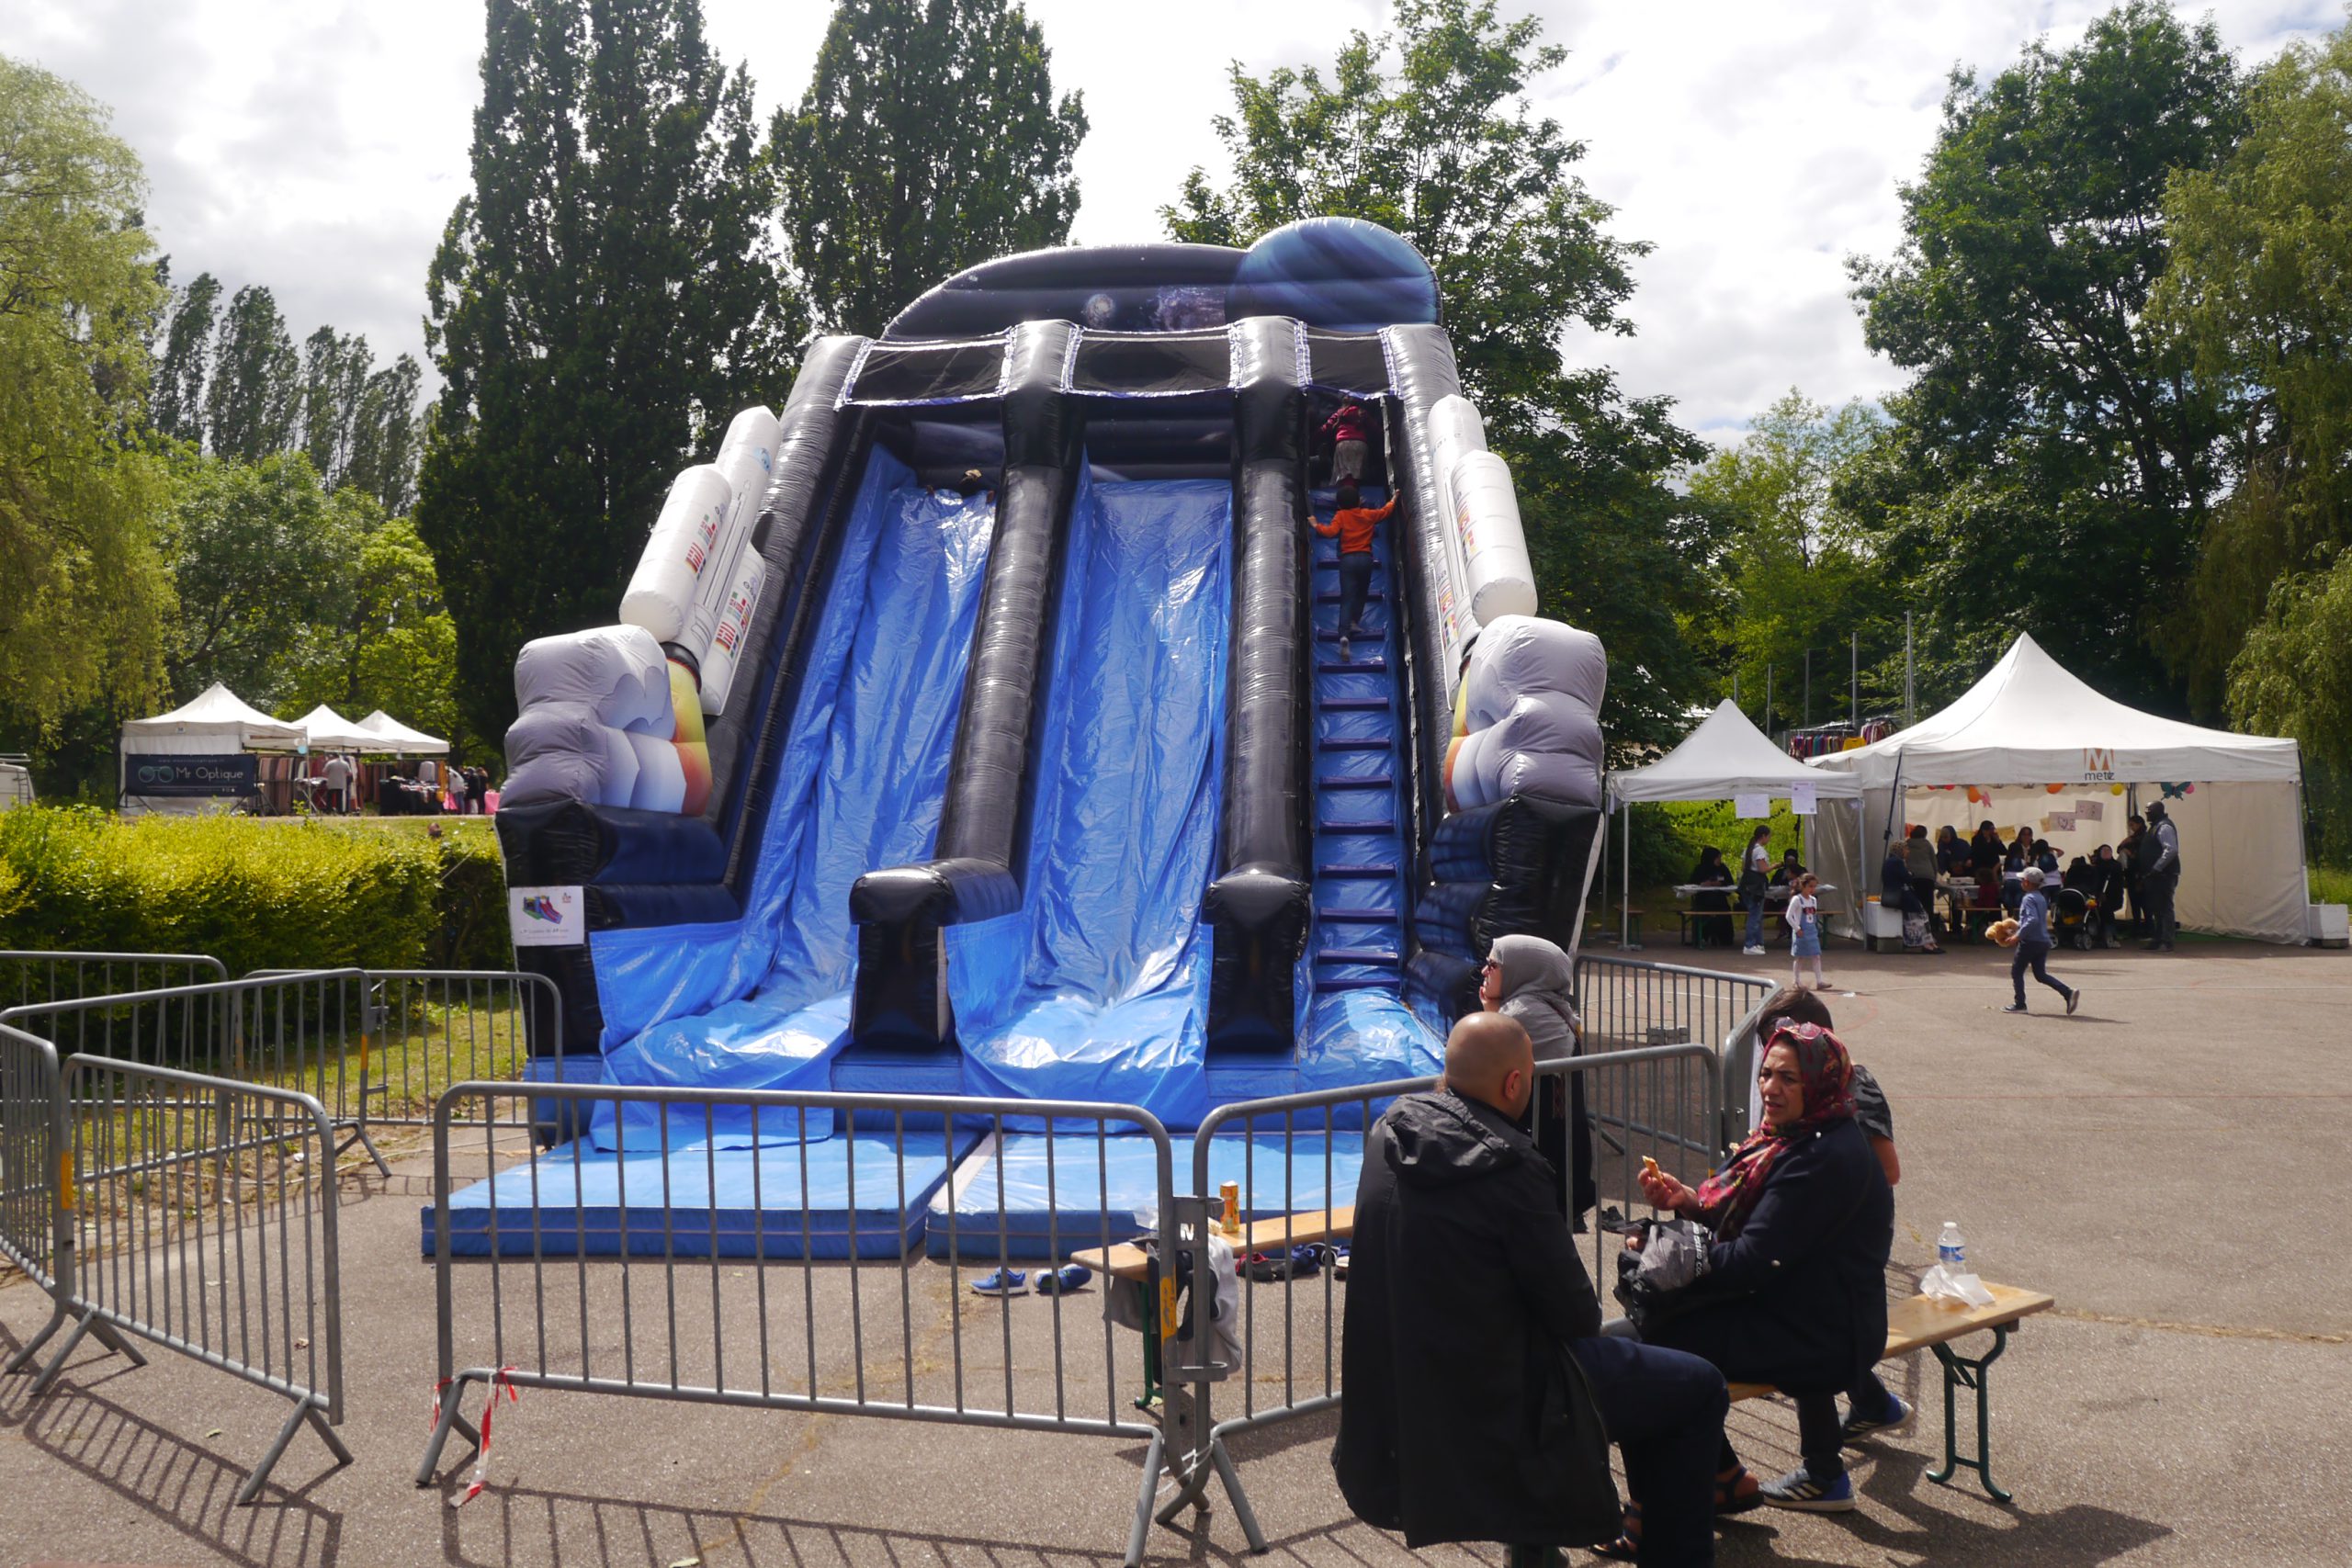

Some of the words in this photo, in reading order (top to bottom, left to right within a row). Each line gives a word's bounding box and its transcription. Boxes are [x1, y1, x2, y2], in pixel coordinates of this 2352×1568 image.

[175, 767, 191, 779] Mr
[196, 766, 243, 782] Optique
[2084, 772, 2115, 781] metz
